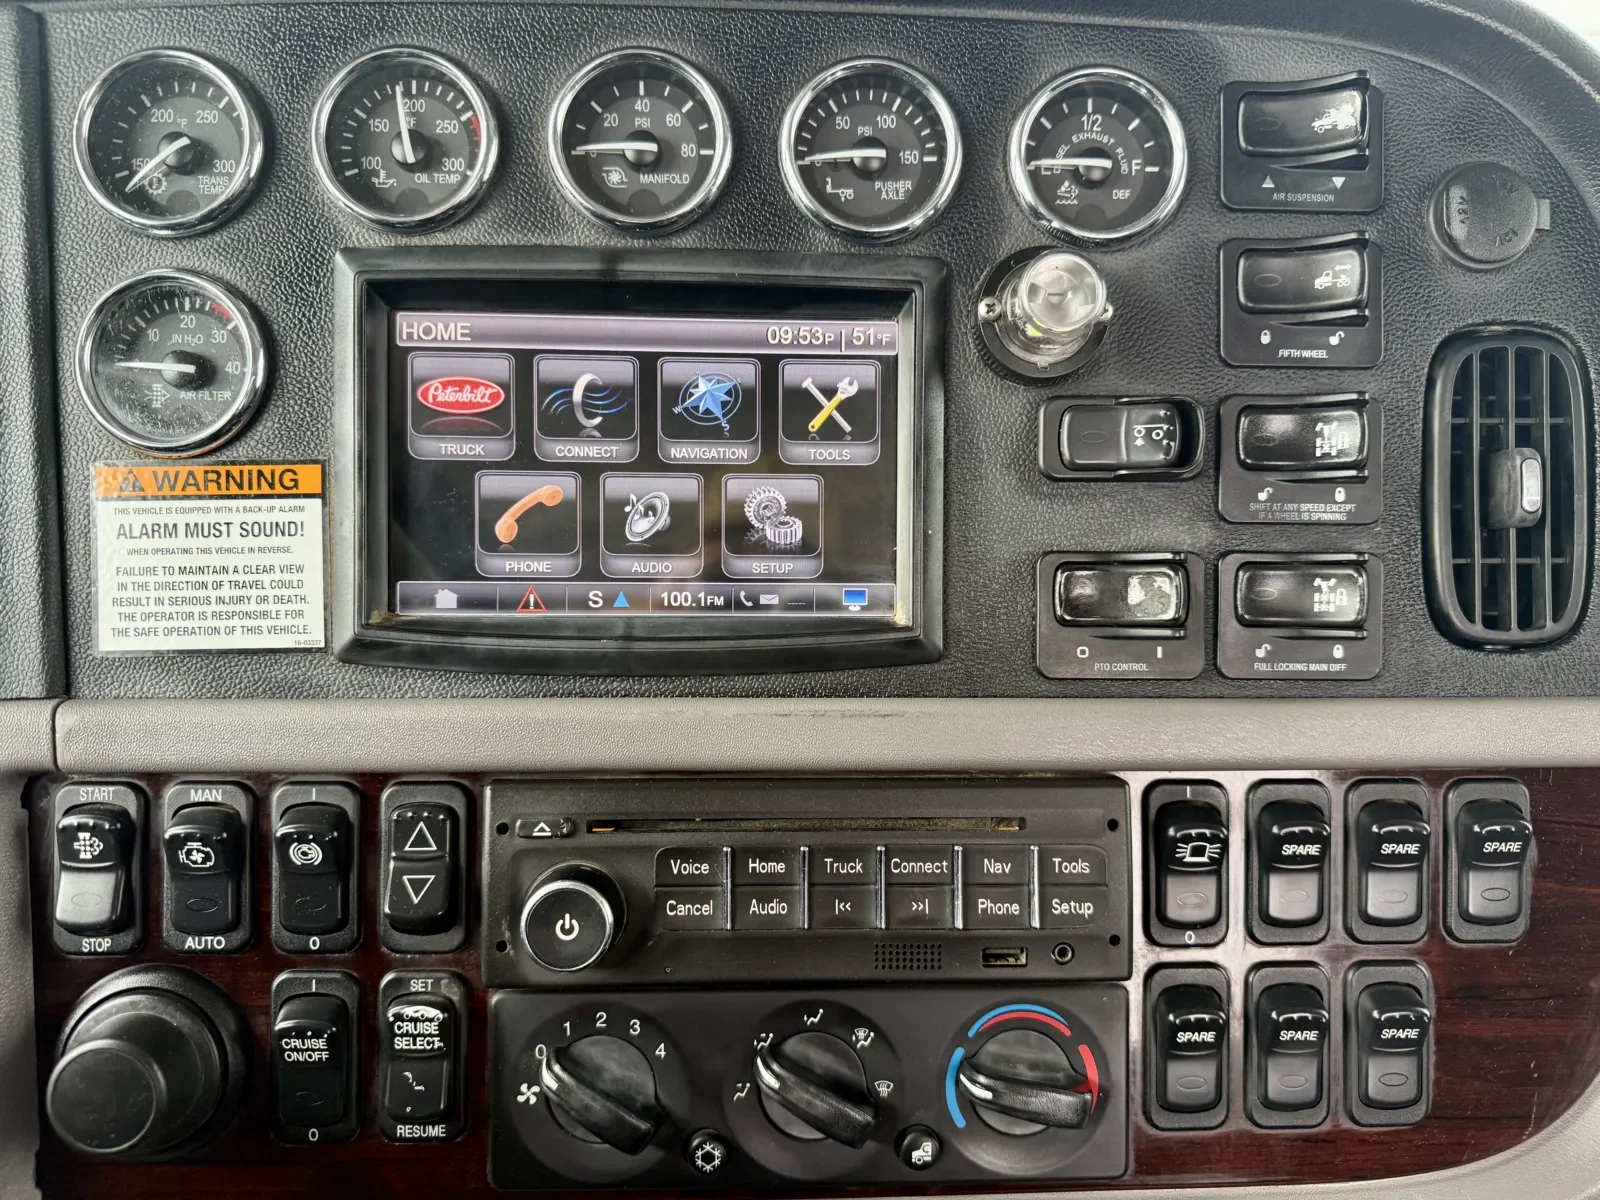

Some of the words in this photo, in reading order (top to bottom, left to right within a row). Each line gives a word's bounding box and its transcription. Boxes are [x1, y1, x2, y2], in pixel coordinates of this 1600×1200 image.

[403, 100, 425, 113] 200
[635, 100, 650, 112] 40
[151, 109, 173, 122] 200
[196, 110, 219, 123] 250
[604, 114, 619, 127] 20
[666, 114, 681, 127] 60
[876, 115, 896, 128] 100
[368, 119, 389, 132] 150
[436, 120, 458, 134] 250
[635, 118, 651, 128] PSI
[836, 116, 850, 129] 50
[1081, 114, 1102, 131] 1/2
[858, 127, 872, 136] PSI
[681, 144, 696, 157] 80
[1071, 132, 1115, 146] EXHAUST
[1115, 147, 1129, 175] FLUID
[361, 156, 381, 169] 100
[899, 151, 919, 164] 150
[213, 160, 236, 173] 300
[442, 158, 464, 171] 300
[1132, 160, 1142, 176] F
[198, 176, 229, 186] TRANS
[415, 174, 430, 183] OIL
[434, 174, 460, 184] TEMP
[640, 174, 690, 184] MANIFOLD
[199, 185, 225, 195] TEMP
[875, 181, 912, 191] PUSHER
[881, 191, 905, 200] AXLE
[1113, 189, 1131, 199] DEF
[1272, 193, 1286, 201] AIR
[1287, 193, 1335, 202] SUSPENSION
[180, 315, 195, 328] 20
[147, 329, 159, 341] 10
[212, 331, 226, 343] 30
[402, 322, 471, 341] HOME
[172, 334, 184, 343] IN
[1277, 349, 1300, 358] FIFTH
[1301, 349, 1329, 359] WHEEL
[225, 362, 240, 374] 40
[180, 391, 196, 399] AIR
[198, 391, 231, 400] FILTER
[427, 383, 498, 404] Peterbilt
[439, 444, 485, 456] TRUCK
[555, 446, 620, 458] CONNECT
[671, 447, 747, 459] NAVIGATION
[808, 449, 851, 460] TOOLS
[152, 469, 299, 492] WARNING
[114, 508, 130, 516] THIS
[132, 507, 164, 515] VEHICLE
[166, 507, 173, 515] IS
[175, 506, 211, 515] EQUIPPED
[214, 506, 233, 514] WITH
[235, 506, 241, 514] A
[242, 505, 276, 514] BACK-UP
[278, 505, 305, 513] ALARM
[1249, 503, 1270, 511] SHIFT
[1272, 503, 1282, 511] AT
[1283, 503, 1298, 512] ANY
[1300, 504, 1324, 512] SPEED
[1326, 504, 1356, 512] EXCEPT
[116, 523, 178, 540] ALARM
[185, 522, 233, 539] MUST
[239, 521, 304, 538] SOUND!
[127, 548, 149, 556] WHEN
[151, 547, 194, 555] OPERATING
[196, 547, 213, 555] THIS
[215, 546, 246, 555] VEHICLE
[248, 546, 256, 554] IN
[116, 566, 159, 576] FAILURE
[162, 566, 175, 576] TO
[178, 565, 229, 575] MAINTAIN
[232, 565, 240, 575] A
[243, 564, 276, 575] CLEAR
[279, 564, 305, 574] VIEW
[505, 562, 552, 573] PHONE
[632, 563, 672, 574] AUDIO
[752, 563, 794, 574] SETUP
[117, 582, 128, 592] IN
[131, 581, 151, 591] THE
[154, 581, 208, 591] DIRECTION
[212, 580, 225, 590] OF
[228, 580, 267, 590] TRAVEL
[270, 579, 304, 589] COULD
[112, 597, 151, 607] RESULT
[154, 596, 165, 606] IN
[168, 596, 212, 606] SERIOUS
[215, 595, 252, 605] INJURY
[256, 595, 269, 605] OR
[273, 594, 309, 604] DEATH.
[588, 591, 603, 608] S
[117, 612, 137, 622] THE
[140, 611, 195, 622] OPERATOR
[199, 611, 208, 621] IS
[211, 610, 282, 621] RESPONSIBLE
[285, 609, 305, 620] FOR
[111, 627, 131, 637] THE
[133, 627, 160, 637] SAFE
[163, 626, 221, 636] OPERATION
[224, 625, 237, 636] OF
[240, 625, 263, 635] THIS
[267, 624, 312, 635] VEHICLE.
[1094, 663, 1110, 671] PTO
[1112, 663, 1149, 672] CONTROL
[1254, 662, 1273, 671] FULL
[1274, 663, 1307, 671] LOCKING
[1309, 663, 1328, 671] MAIN
[1329, 664, 1347, 672] DIFF
[80, 788, 115, 801] START
[190, 788, 222, 801] MAN
[1281, 844, 1322, 856] SPARE
[1380, 843, 1420, 855] SPARE
[1483, 842, 1522, 853] SPARE
[671, 860, 710, 875] Voice
[749, 859, 785, 873] Home
[824, 858, 863, 873] Truck
[890, 858, 948, 874] Connect
[984, 859, 1011, 874] Nav
[1052, 858, 1091, 875] Tools
[666, 900, 713, 916] Cancel
[750, 899, 788, 915] Audio
[978, 899, 1020, 915] Phone
[1052, 899, 1094, 919] Setup
[82, 938, 112, 951] STOP
[185, 937, 226, 949] AUTO
[410, 979, 434, 992] SET
[596, 1012, 607, 1028] 2
[394, 1022, 439, 1035] CRUISE
[563, 1021, 571, 1036] 1
[630, 1019, 641, 1035] 3
[1176, 1031, 1216, 1043] SPARE
[1279, 1030, 1319, 1041] SPARE
[1381, 1028, 1420, 1040] SPARE
[282, 1038, 328, 1049] CRUISE
[394, 1037, 441, 1050] SELECT
[284, 1051, 329, 1062] ON/OFF
[655, 1043, 667, 1059] 4
[397, 1125, 447, 1138] RESUME
